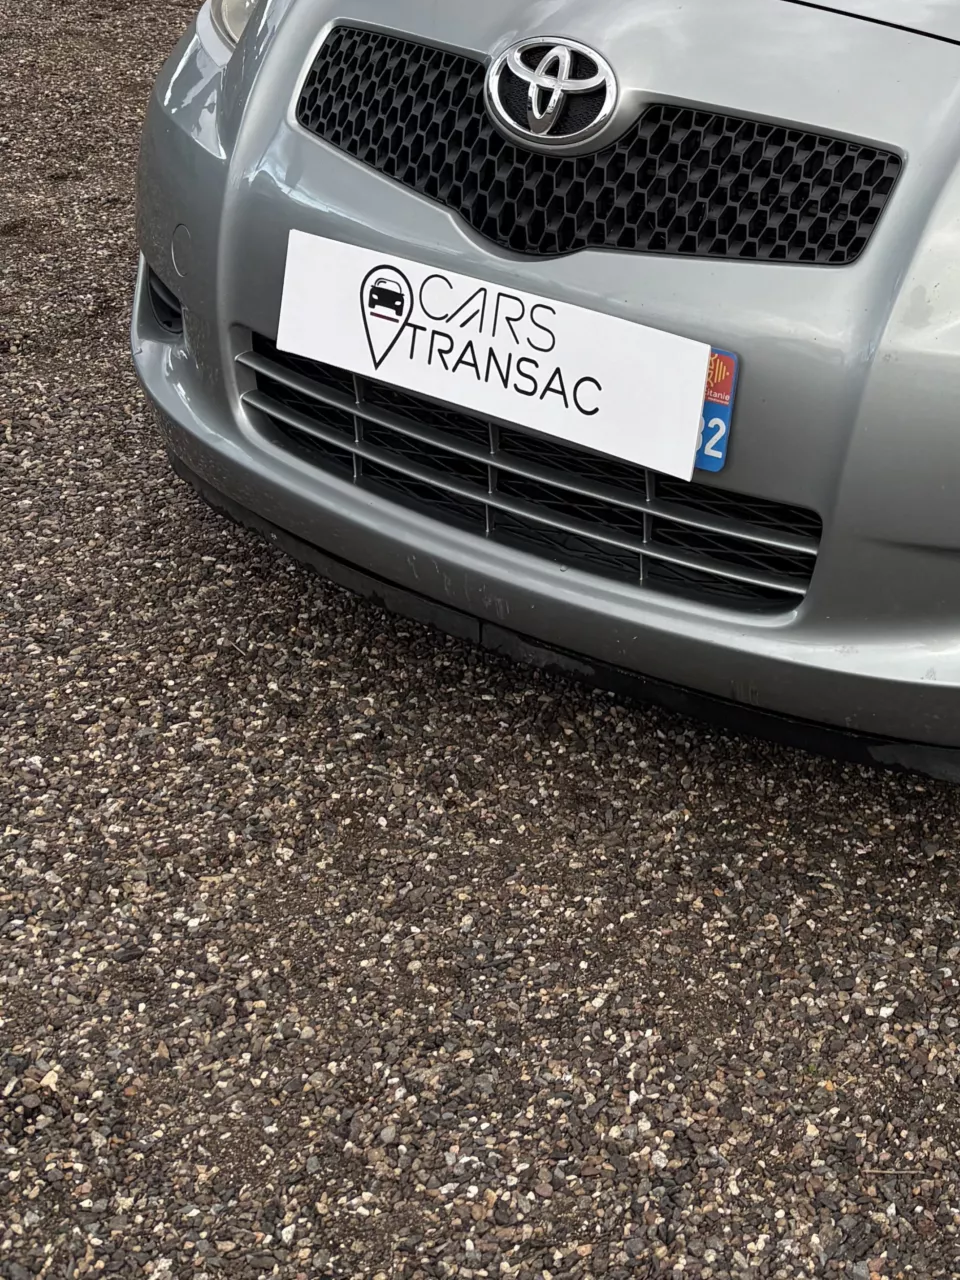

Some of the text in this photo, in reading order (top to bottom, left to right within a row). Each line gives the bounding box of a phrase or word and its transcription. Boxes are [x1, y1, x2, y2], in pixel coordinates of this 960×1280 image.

[418, 273, 557, 353] CARS
[403, 322, 602, 415] TRANSAC
[704, 387, 730, 401] itanie
